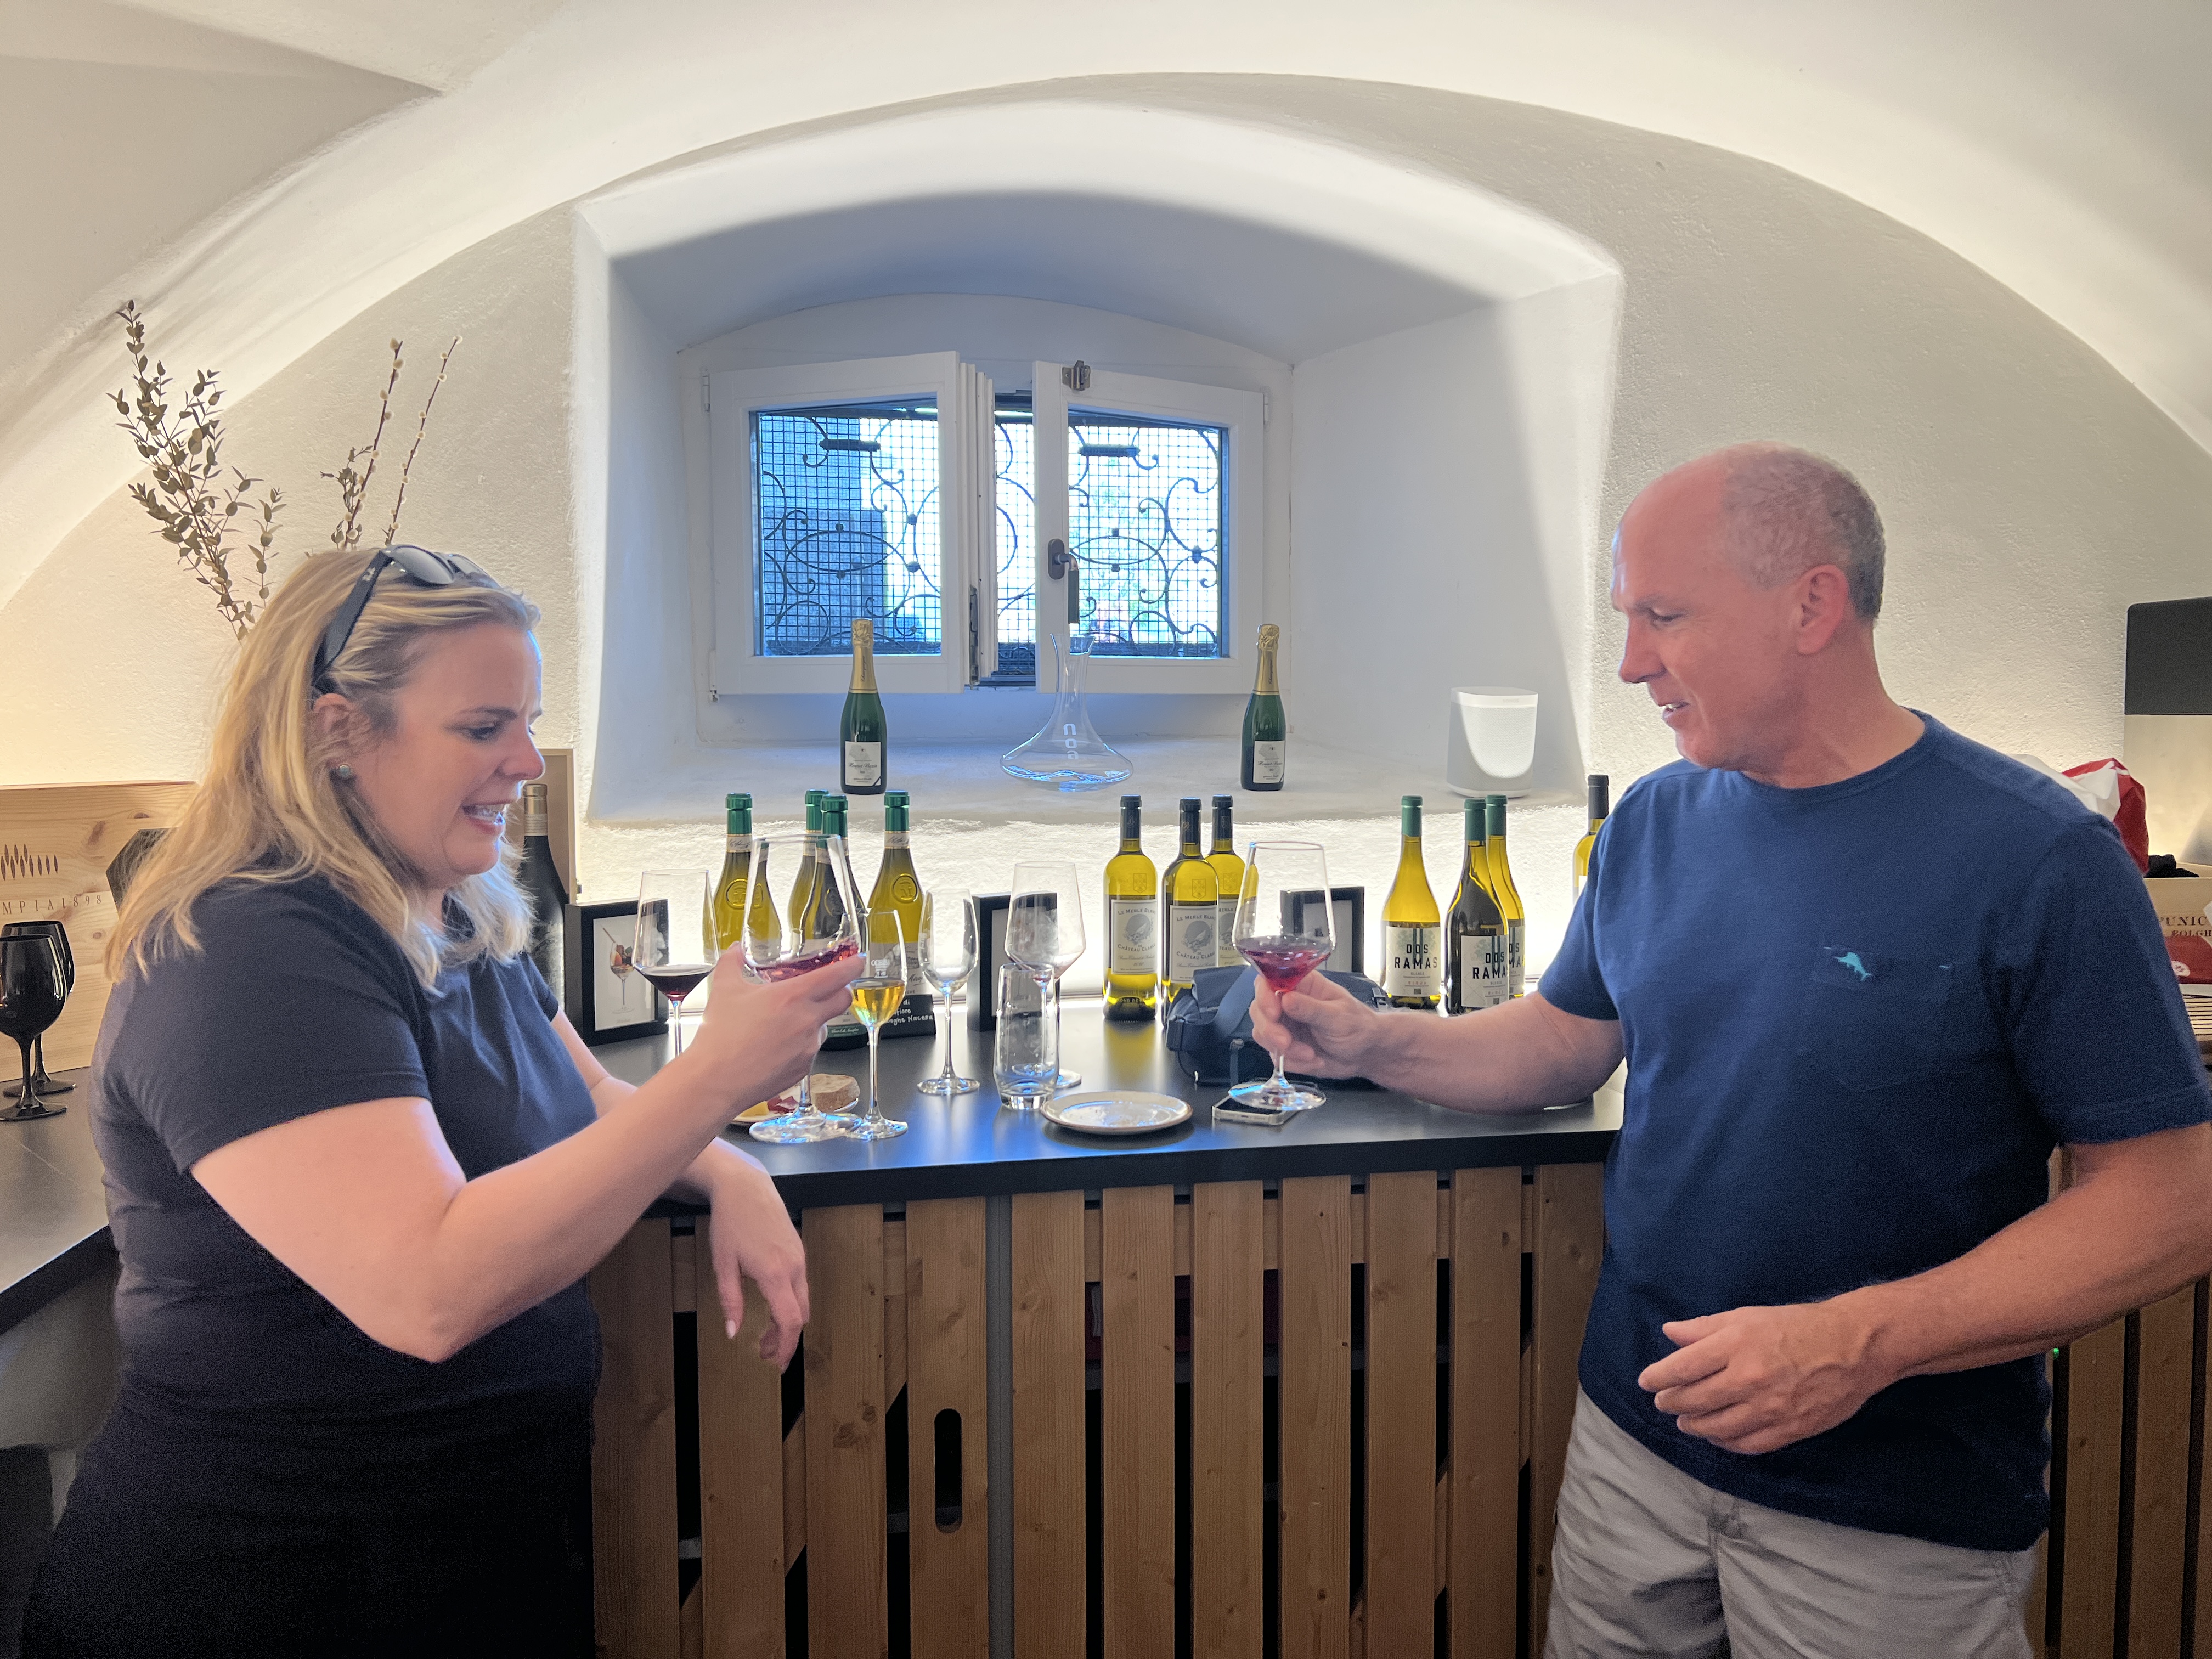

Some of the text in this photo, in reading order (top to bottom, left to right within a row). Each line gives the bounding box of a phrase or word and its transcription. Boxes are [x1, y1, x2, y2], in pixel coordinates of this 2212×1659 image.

[1063, 723, 1079, 760] noa
[1407, 944, 1429, 954] DOS
[1395, 956, 1437, 969] RAMAS
[1486, 952, 1504, 963] DOS
[1472, 966, 1506, 979] RAMA
